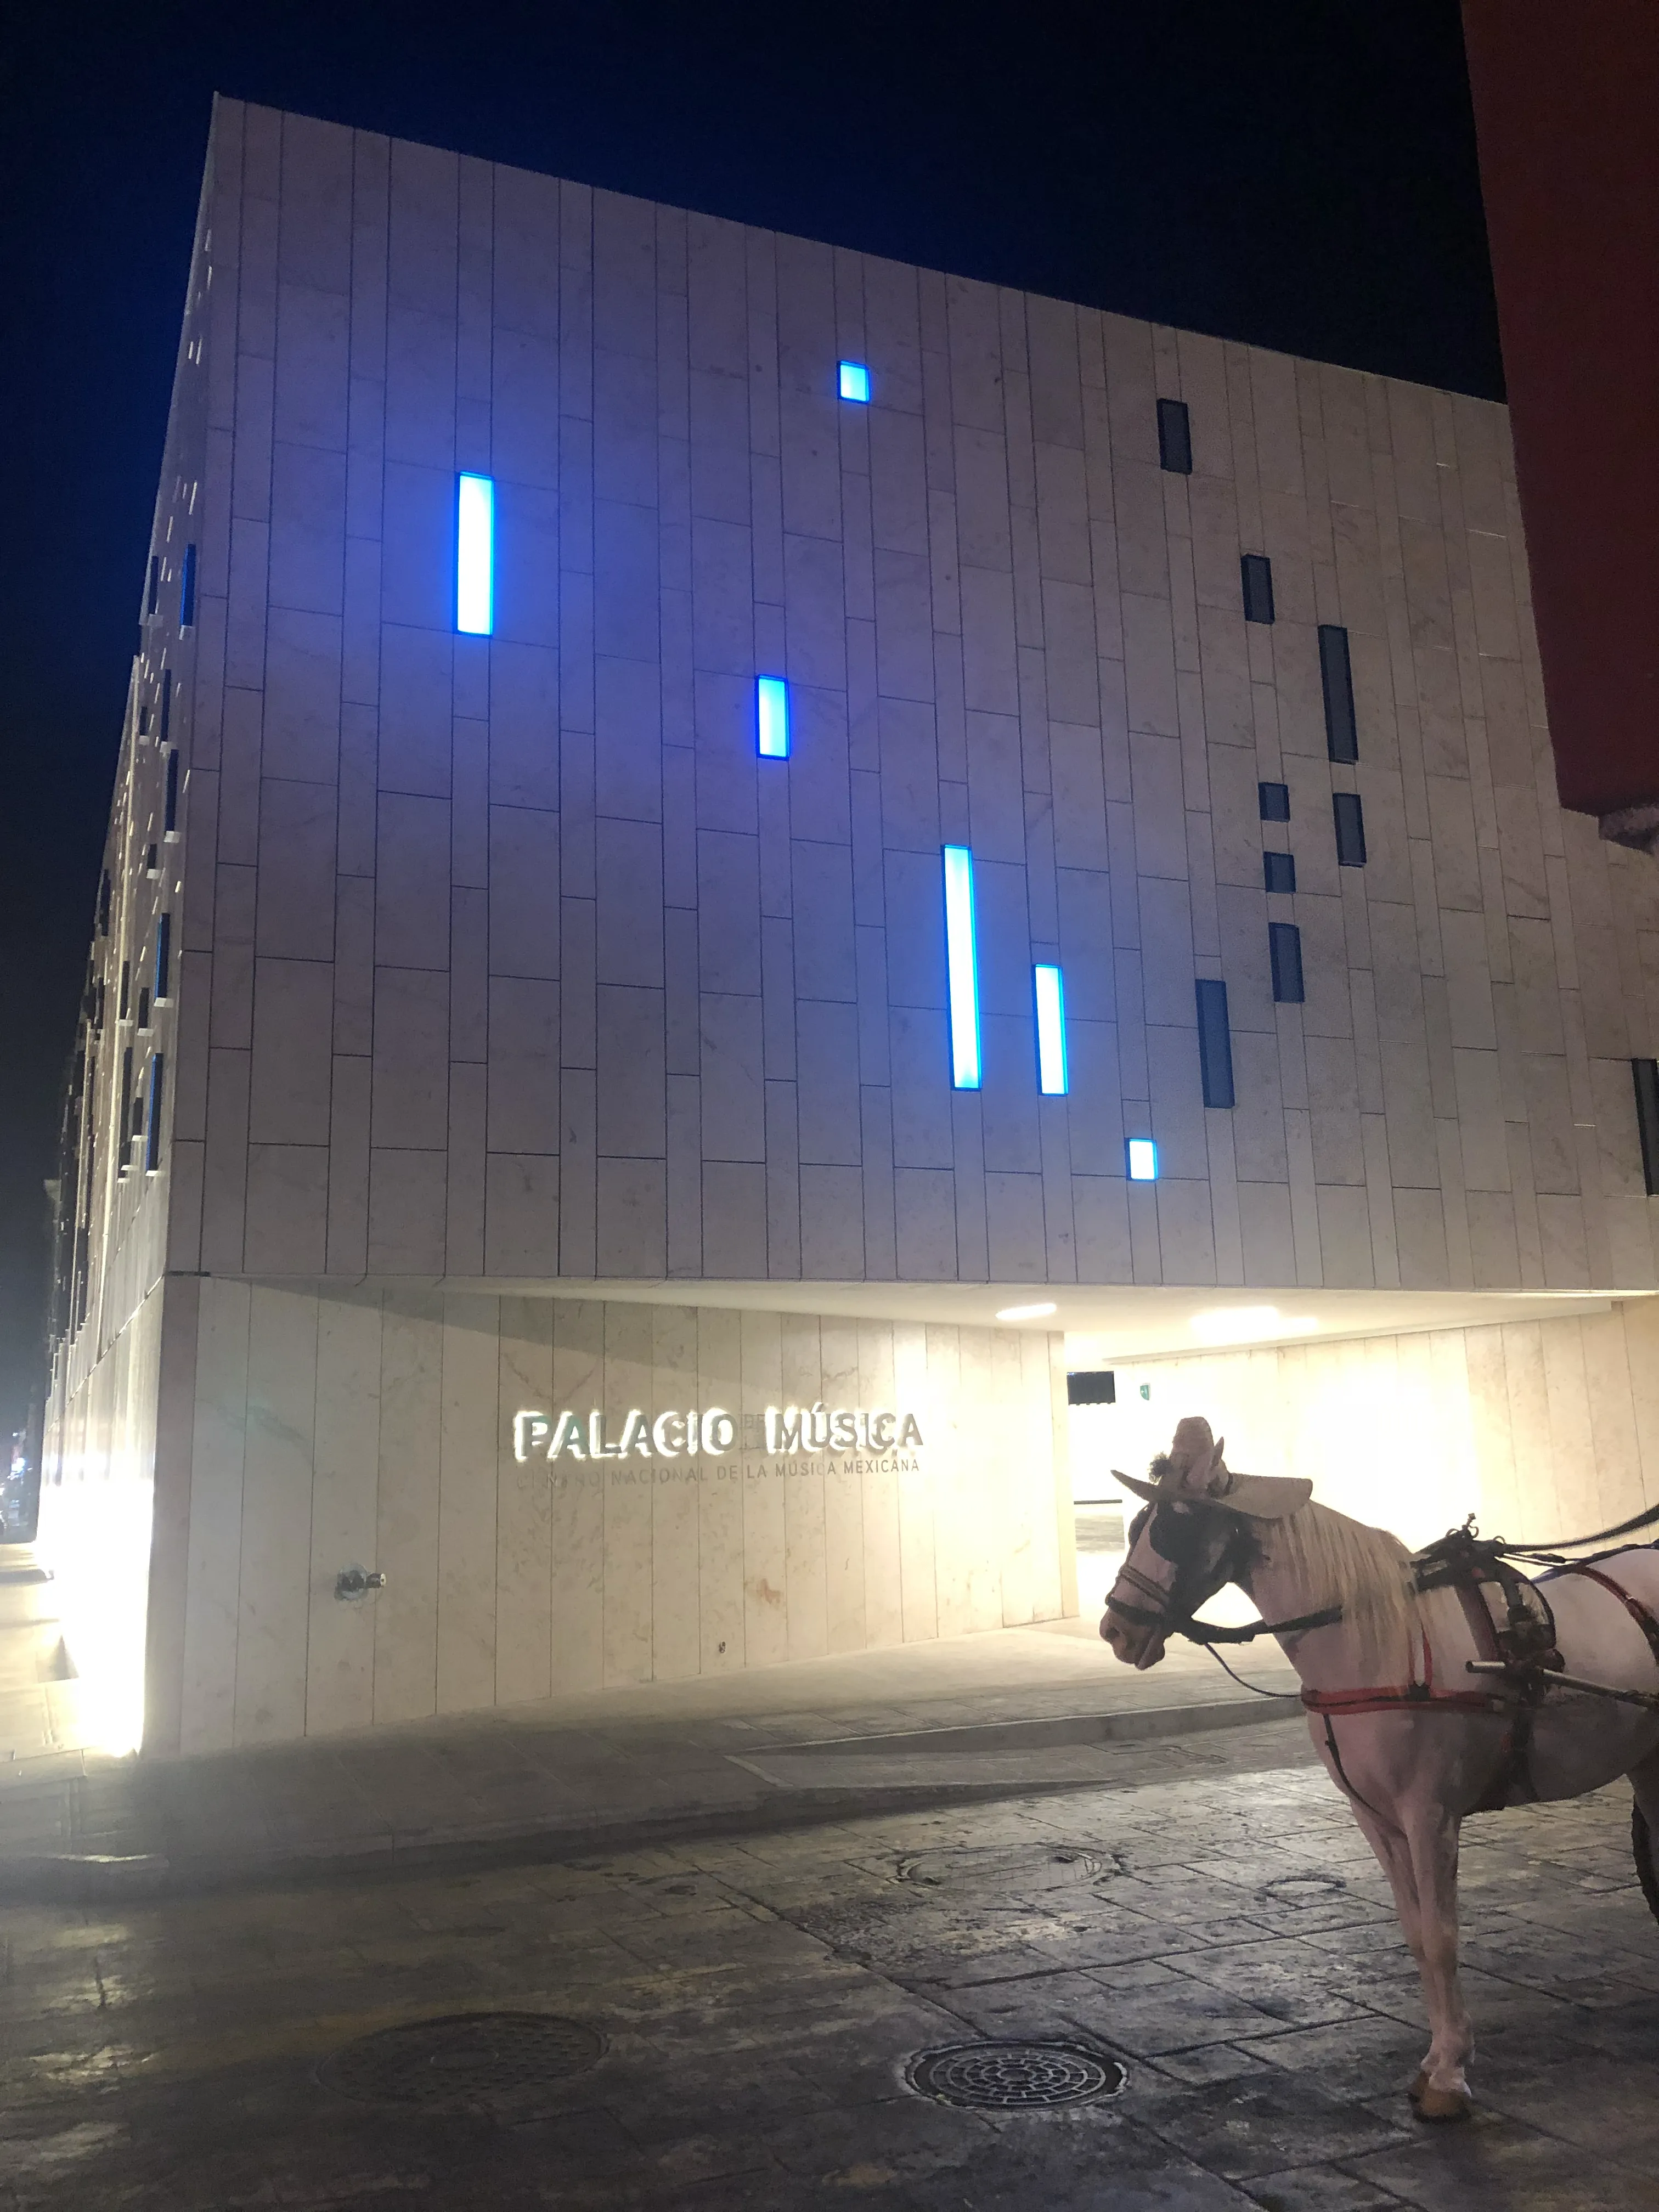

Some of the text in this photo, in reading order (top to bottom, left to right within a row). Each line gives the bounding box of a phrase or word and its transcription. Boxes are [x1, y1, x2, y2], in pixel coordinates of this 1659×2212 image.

[515, 1409, 738, 1460] PALACIO
[766, 1402, 924, 1454] MÚSICA
[611, 1465, 708, 1486] NACIONAL
[716, 1465, 738, 1480] DE
[747, 1464, 767, 1479] LA
[775, 1460, 837, 1477] MÚSICA
[844, 1458, 919, 1475] MEXICANA
